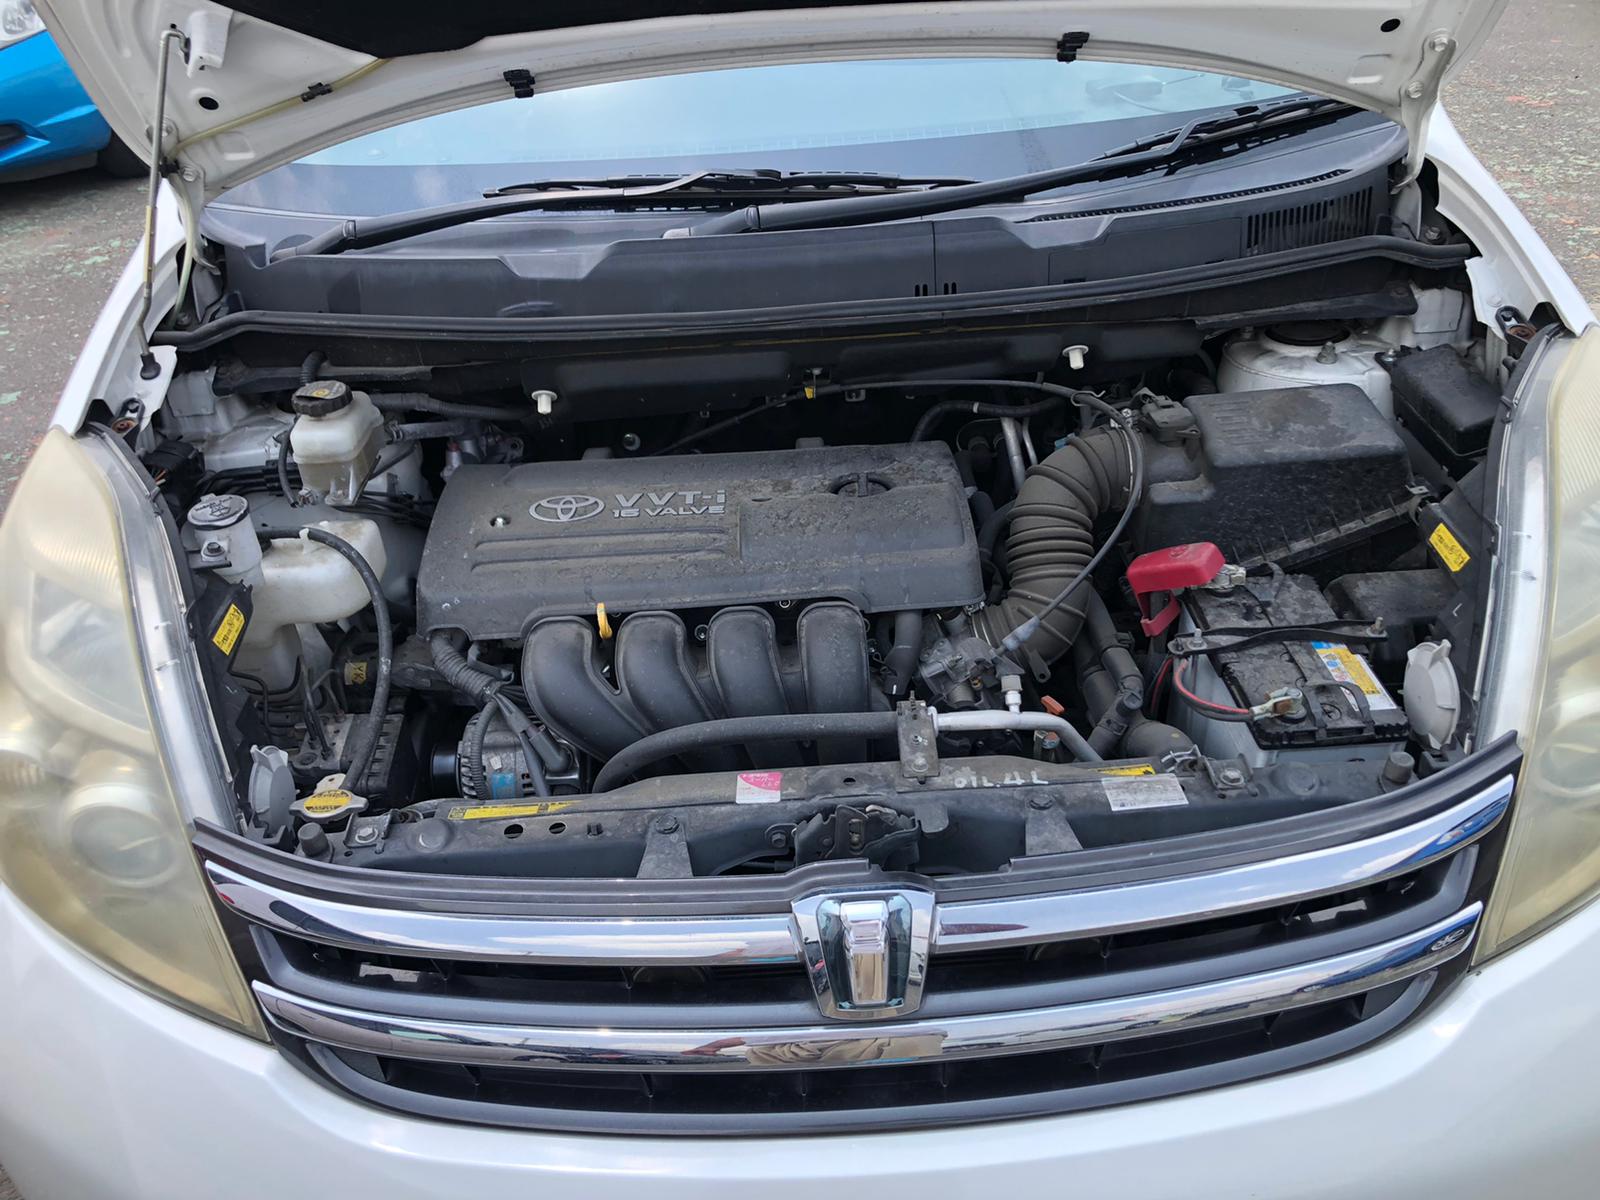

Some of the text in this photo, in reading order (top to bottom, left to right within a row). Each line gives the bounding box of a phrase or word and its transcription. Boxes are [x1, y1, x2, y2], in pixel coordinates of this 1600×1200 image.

[614, 489, 727, 508] VVT-i
[611, 504, 727, 519] 16 VALVE
